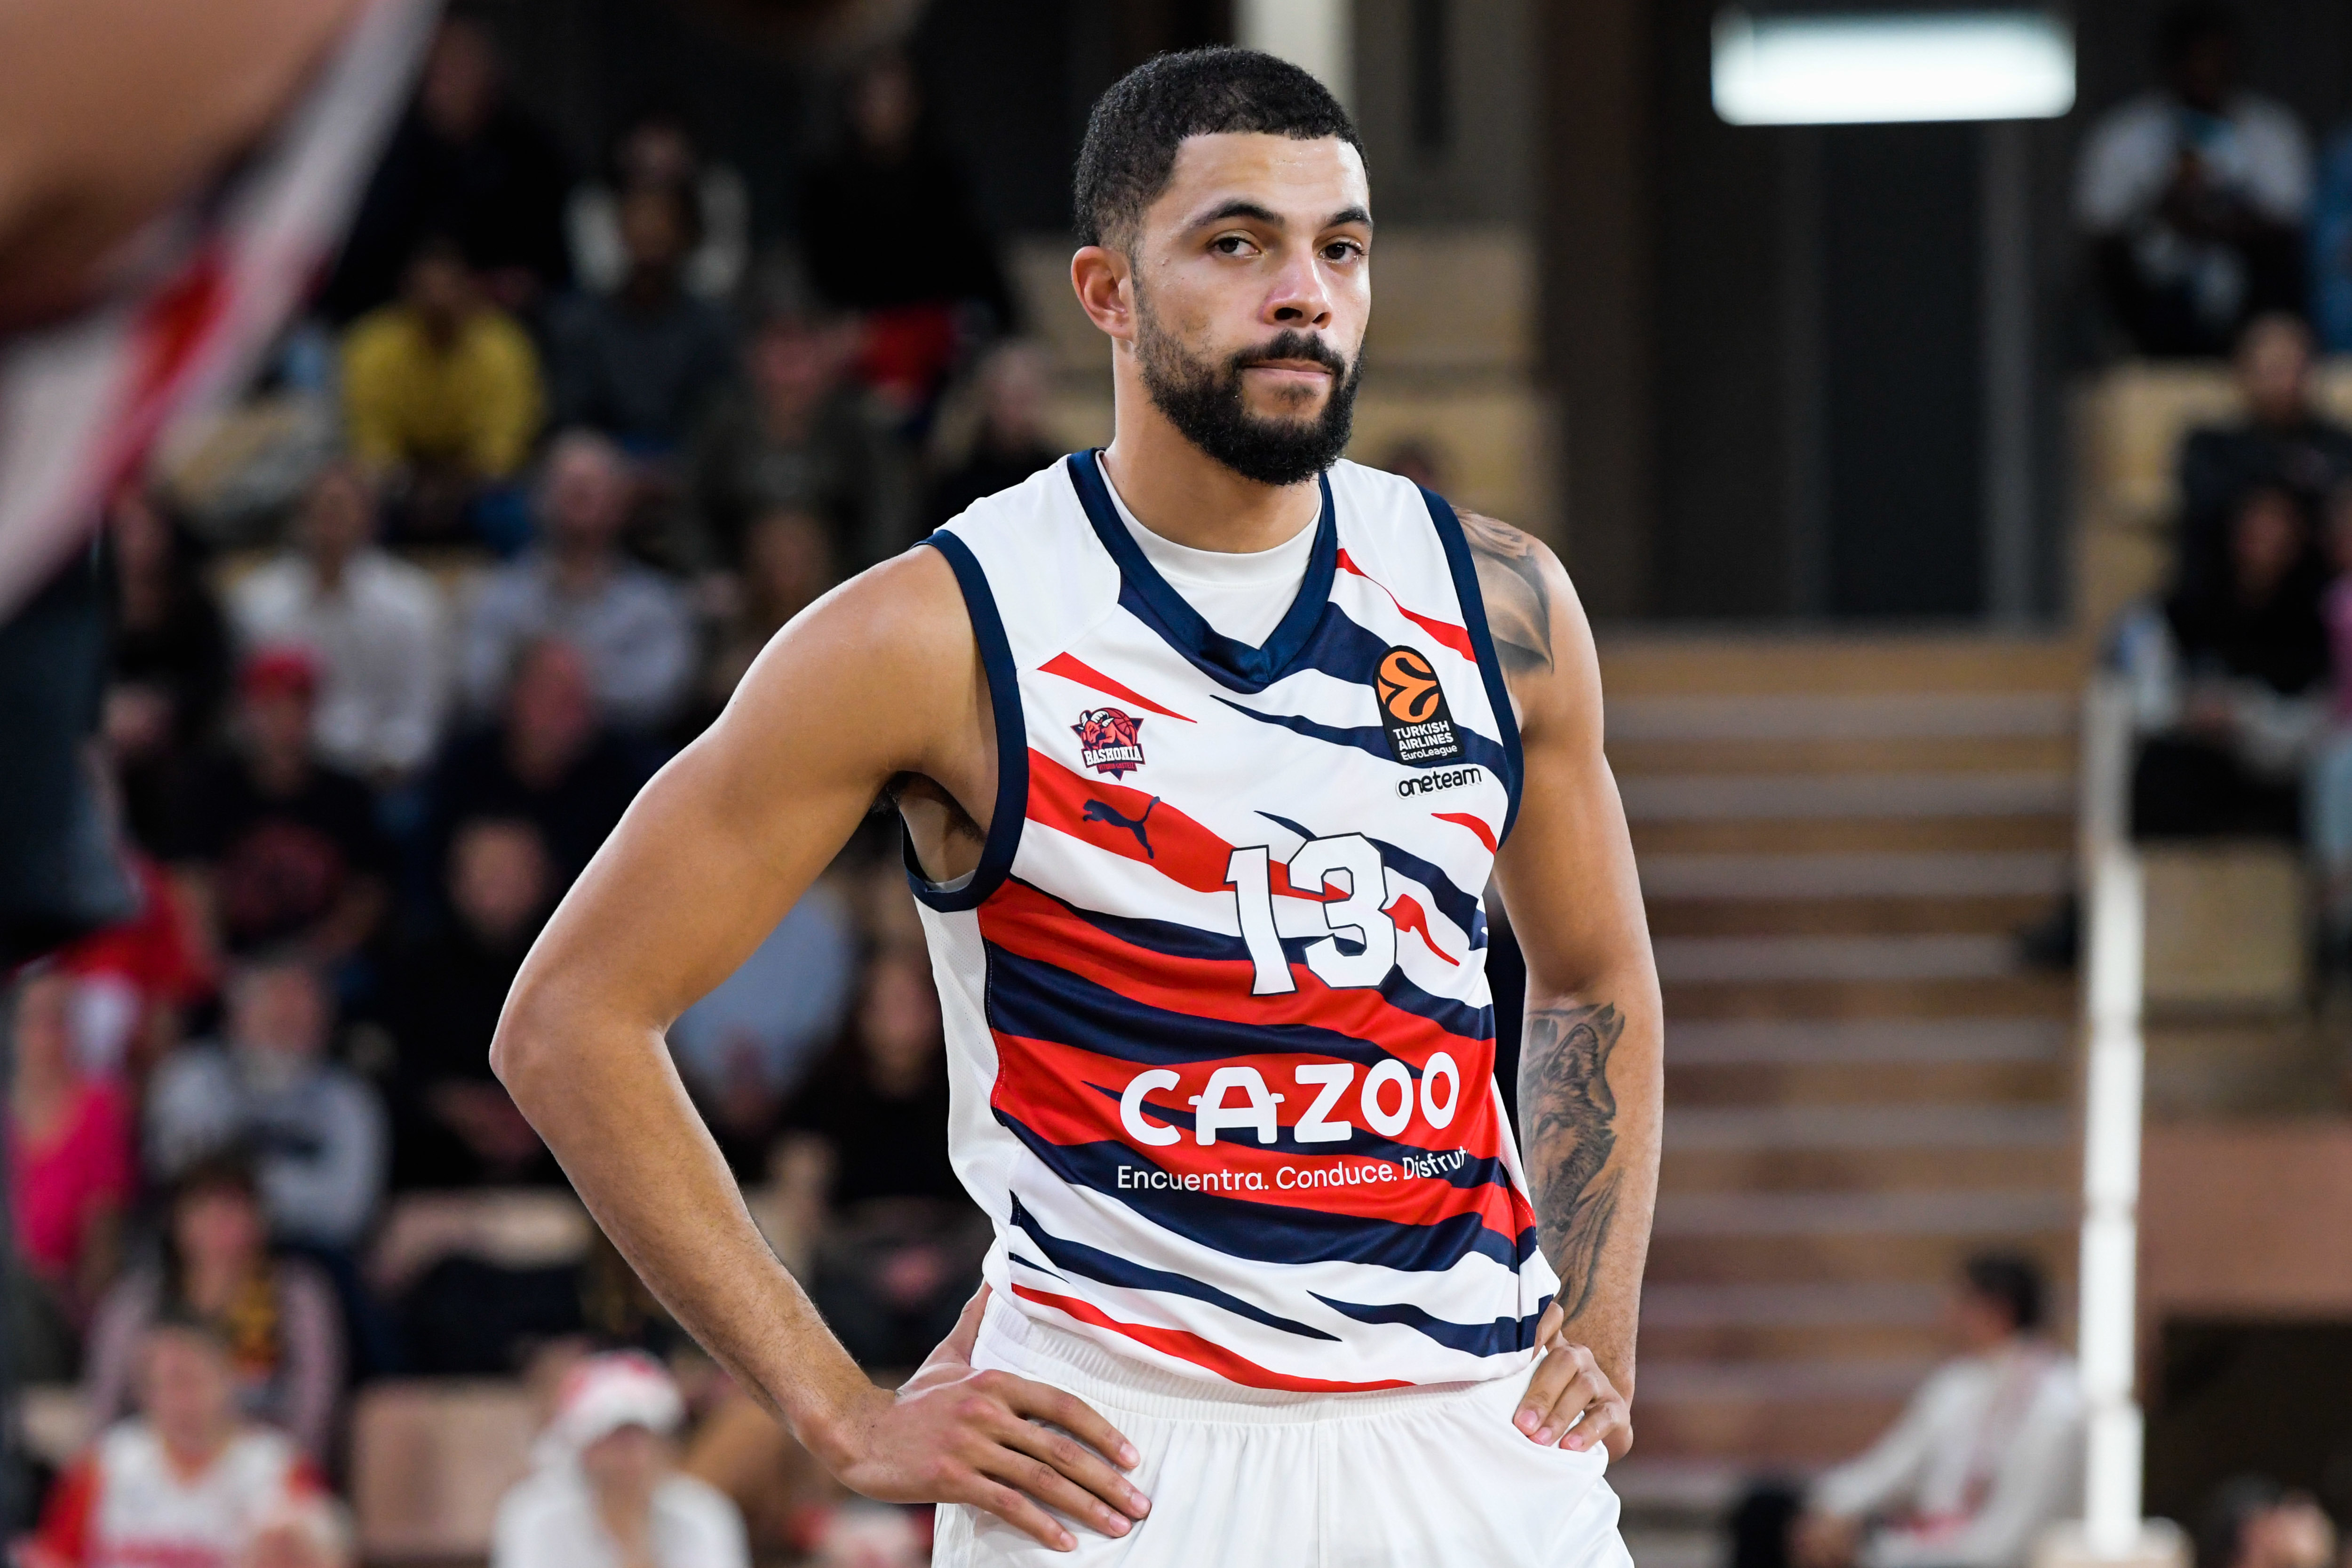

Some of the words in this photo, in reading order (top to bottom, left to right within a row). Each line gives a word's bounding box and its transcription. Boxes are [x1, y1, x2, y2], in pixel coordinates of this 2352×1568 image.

[1393, 721, 1450, 739] TURKISH
[1399, 732, 1454, 751] AIRLINES
[1084, 746, 1143, 766] BASKONIA
[1401, 745, 1457, 760] EuroLeague
[1398, 768, 1482, 797] oneteam
[1224, 832, 1397, 996] 13
[1120, 1051, 1460, 1146] CAZOO
[1117, 1165, 1270, 1191] Encuentra.
[1276, 1161, 1398, 1189] Conduce.
[1402, 1145, 1469, 1180] Disfrut
